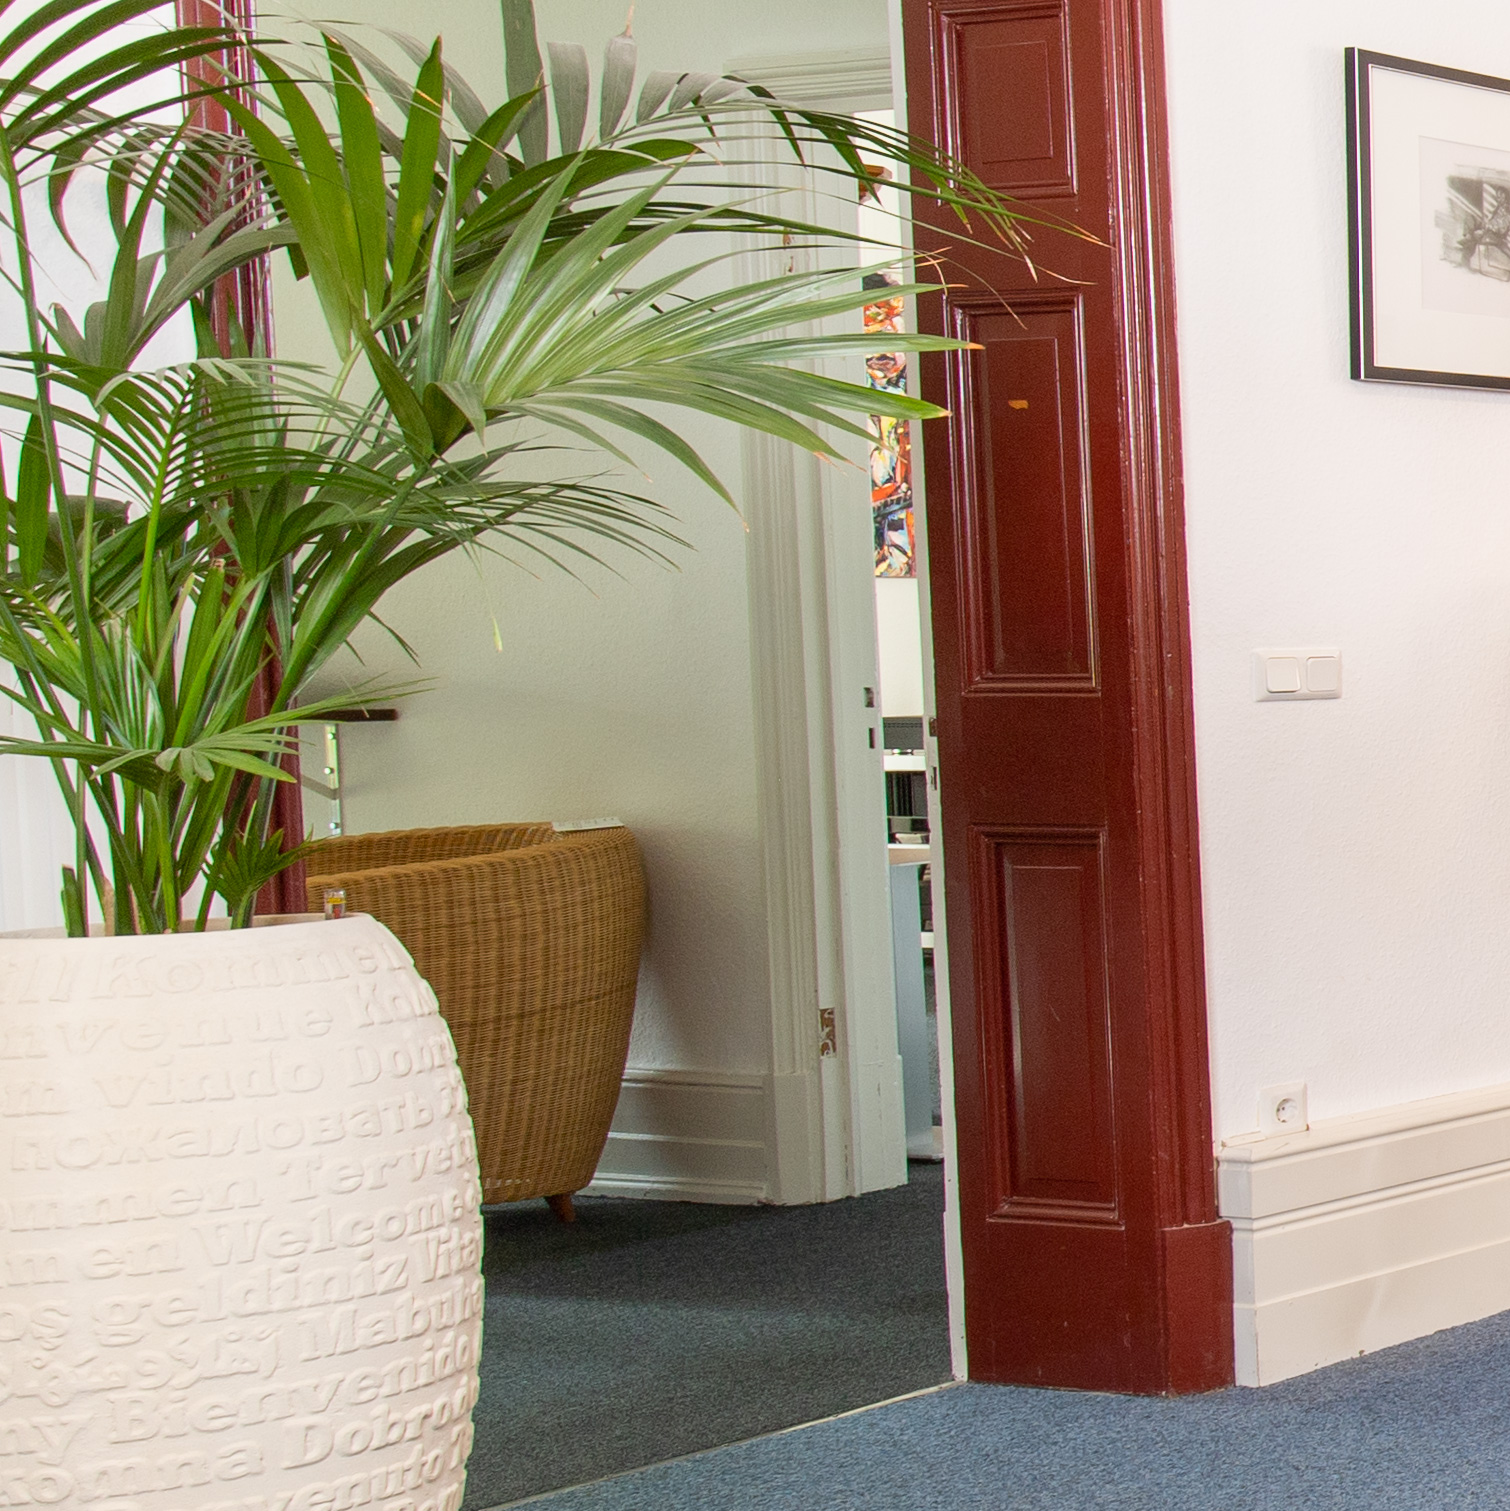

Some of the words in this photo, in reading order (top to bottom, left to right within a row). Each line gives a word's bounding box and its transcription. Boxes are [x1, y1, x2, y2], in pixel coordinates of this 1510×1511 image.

[92, 1048, 325, 1109] vindo
[190, 1187, 464, 1267] Welcome
[91, 1246, 409, 1348] geldiniz
